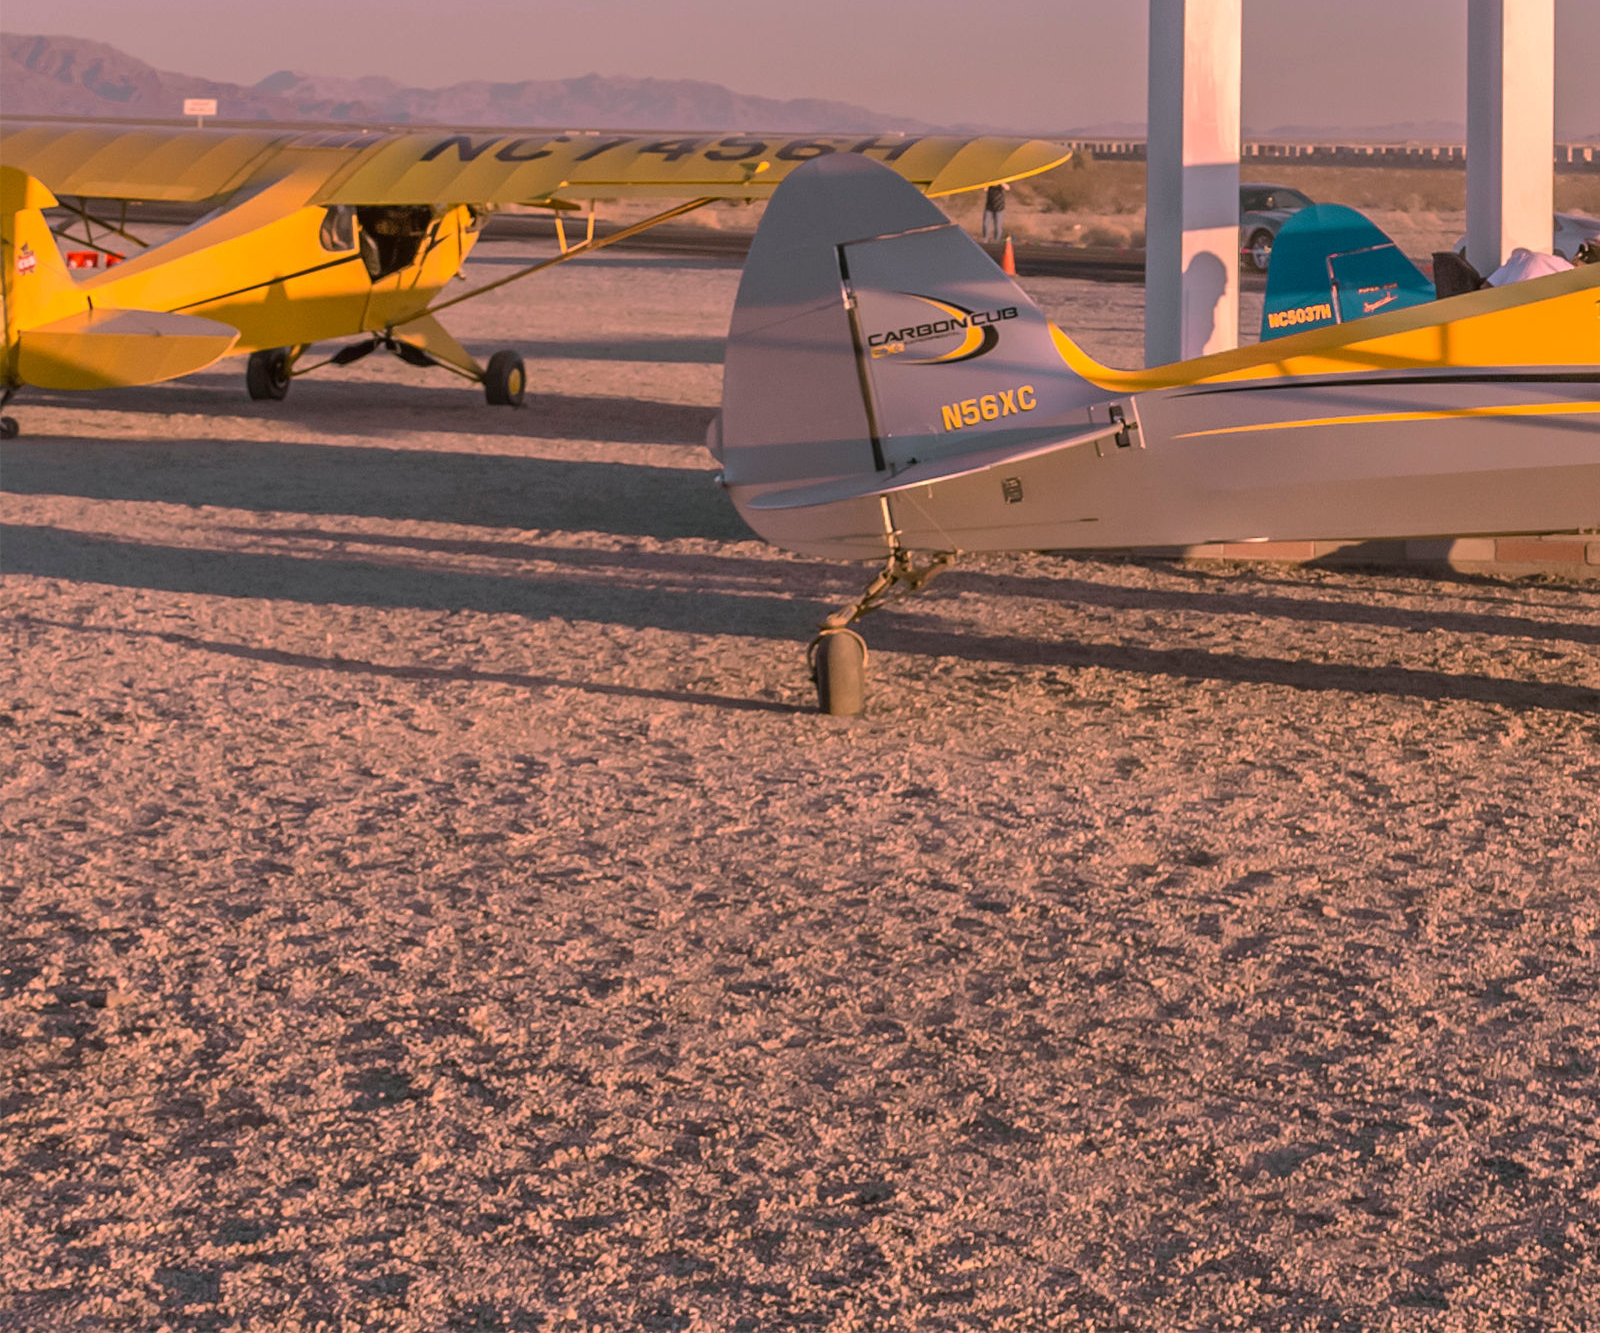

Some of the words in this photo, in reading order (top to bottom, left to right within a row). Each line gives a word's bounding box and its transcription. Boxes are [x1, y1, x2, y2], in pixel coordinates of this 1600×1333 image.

[867, 317, 968, 347] CARBON
[971, 307, 1019, 327] CUB
[1268, 303, 1333, 329] NC5037H
[941, 385, 1037, 432] N56XC
